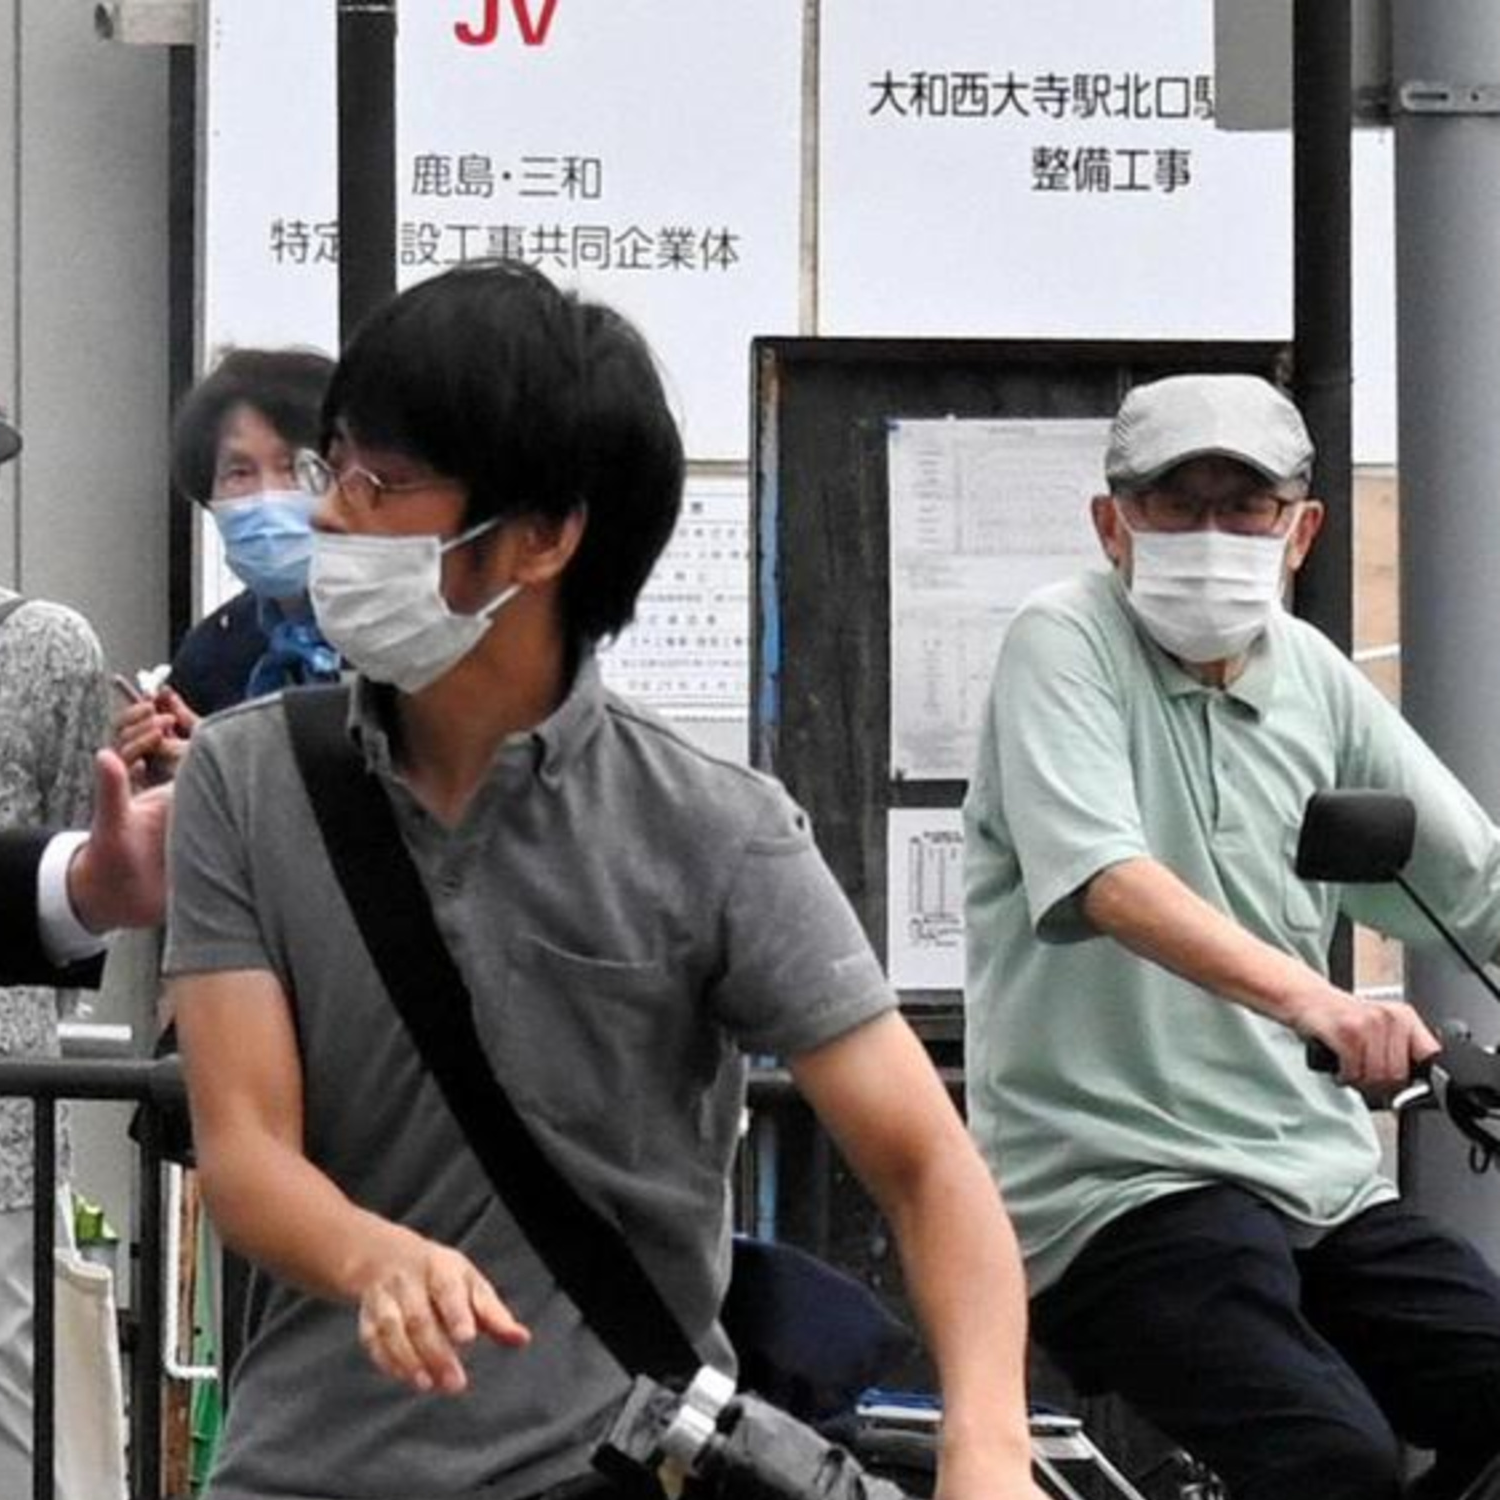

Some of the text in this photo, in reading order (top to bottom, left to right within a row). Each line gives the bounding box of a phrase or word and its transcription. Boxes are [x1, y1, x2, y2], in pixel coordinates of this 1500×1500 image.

[454, 0, 558, 46] JV
[1031, 146, 1191, 193] 整備工事
[270, 219, 739, 270] 特定設工事共同企業体
